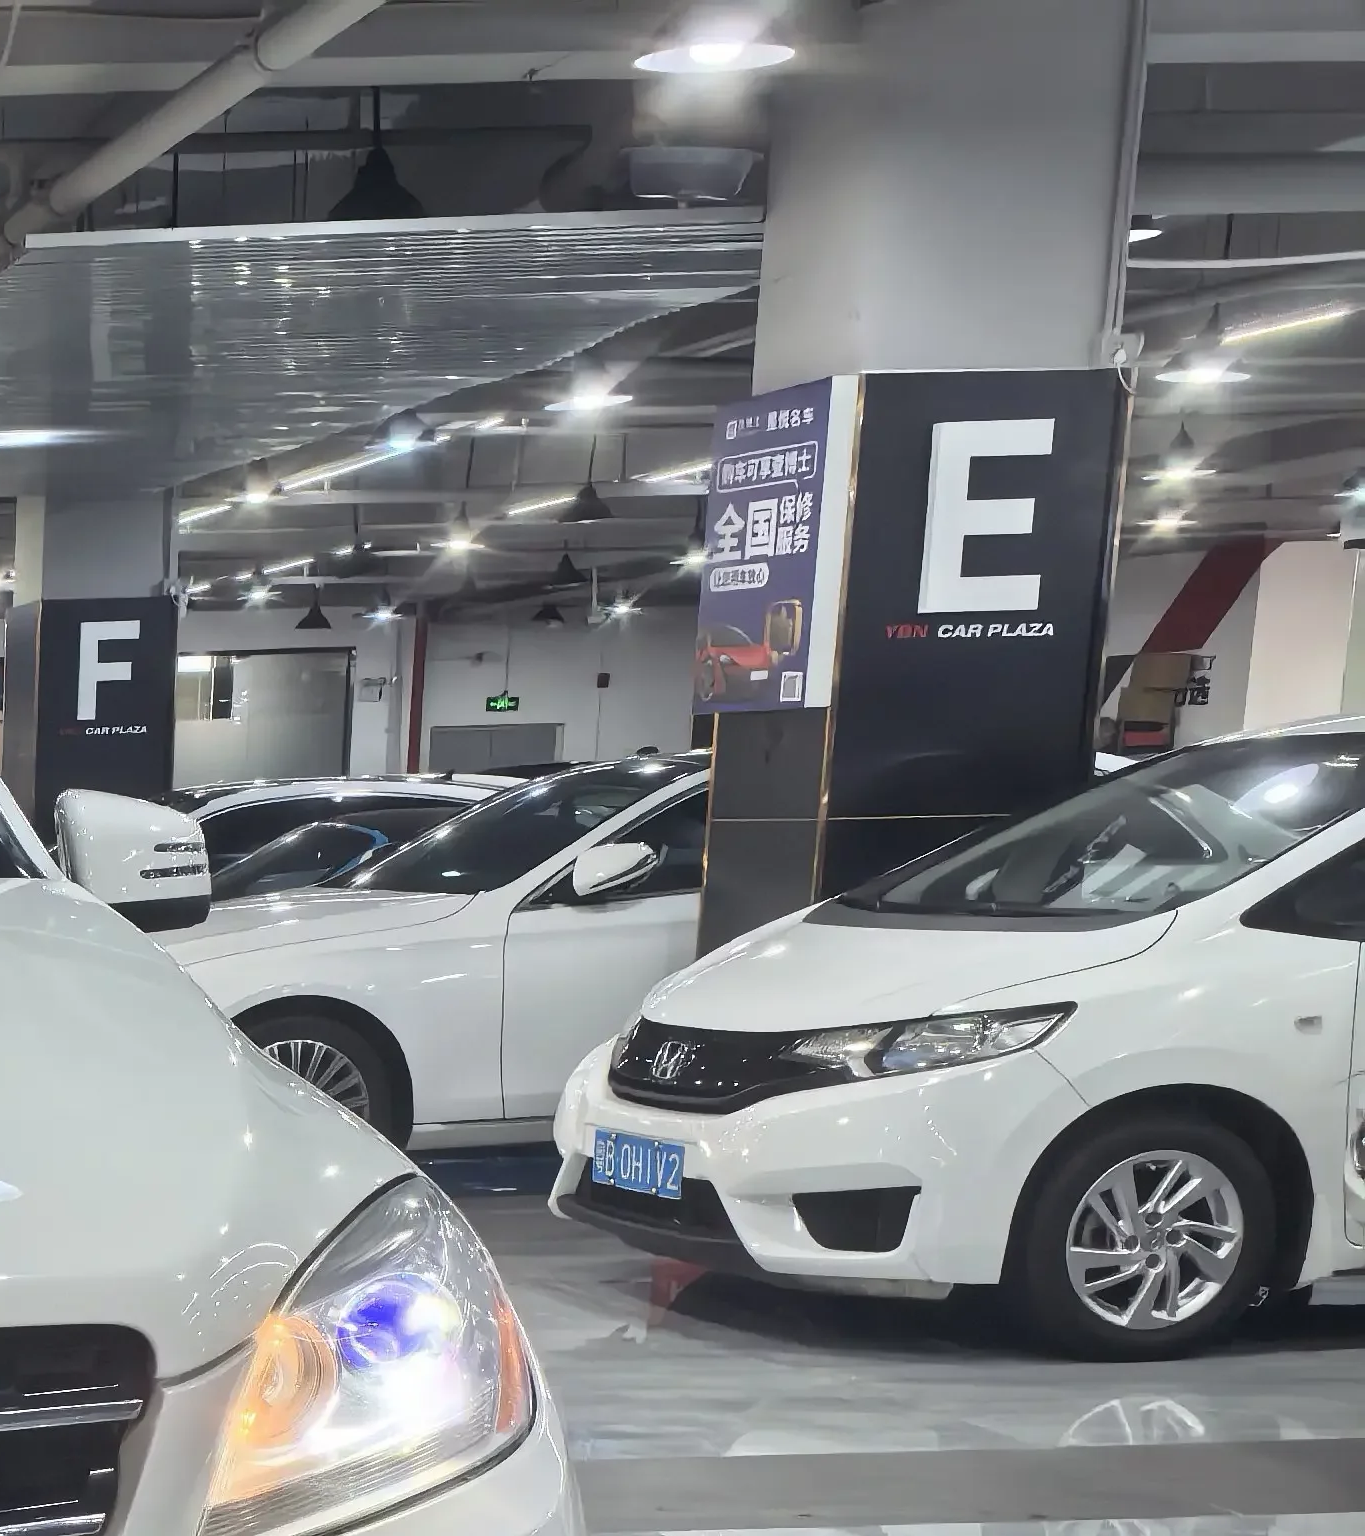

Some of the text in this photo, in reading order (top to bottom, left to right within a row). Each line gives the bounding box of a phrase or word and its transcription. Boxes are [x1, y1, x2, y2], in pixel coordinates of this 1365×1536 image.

[712, 498, 779, 562] 全国
[779, 491, 814, 524] 保修
[918, 418, 1055, 614] E
[775, 523, 811, 556] 服务
[937, 623, 984, 639] CAR
[987, 622, 1055, 638] PLAZA
[76, 619, 141, 721] F
